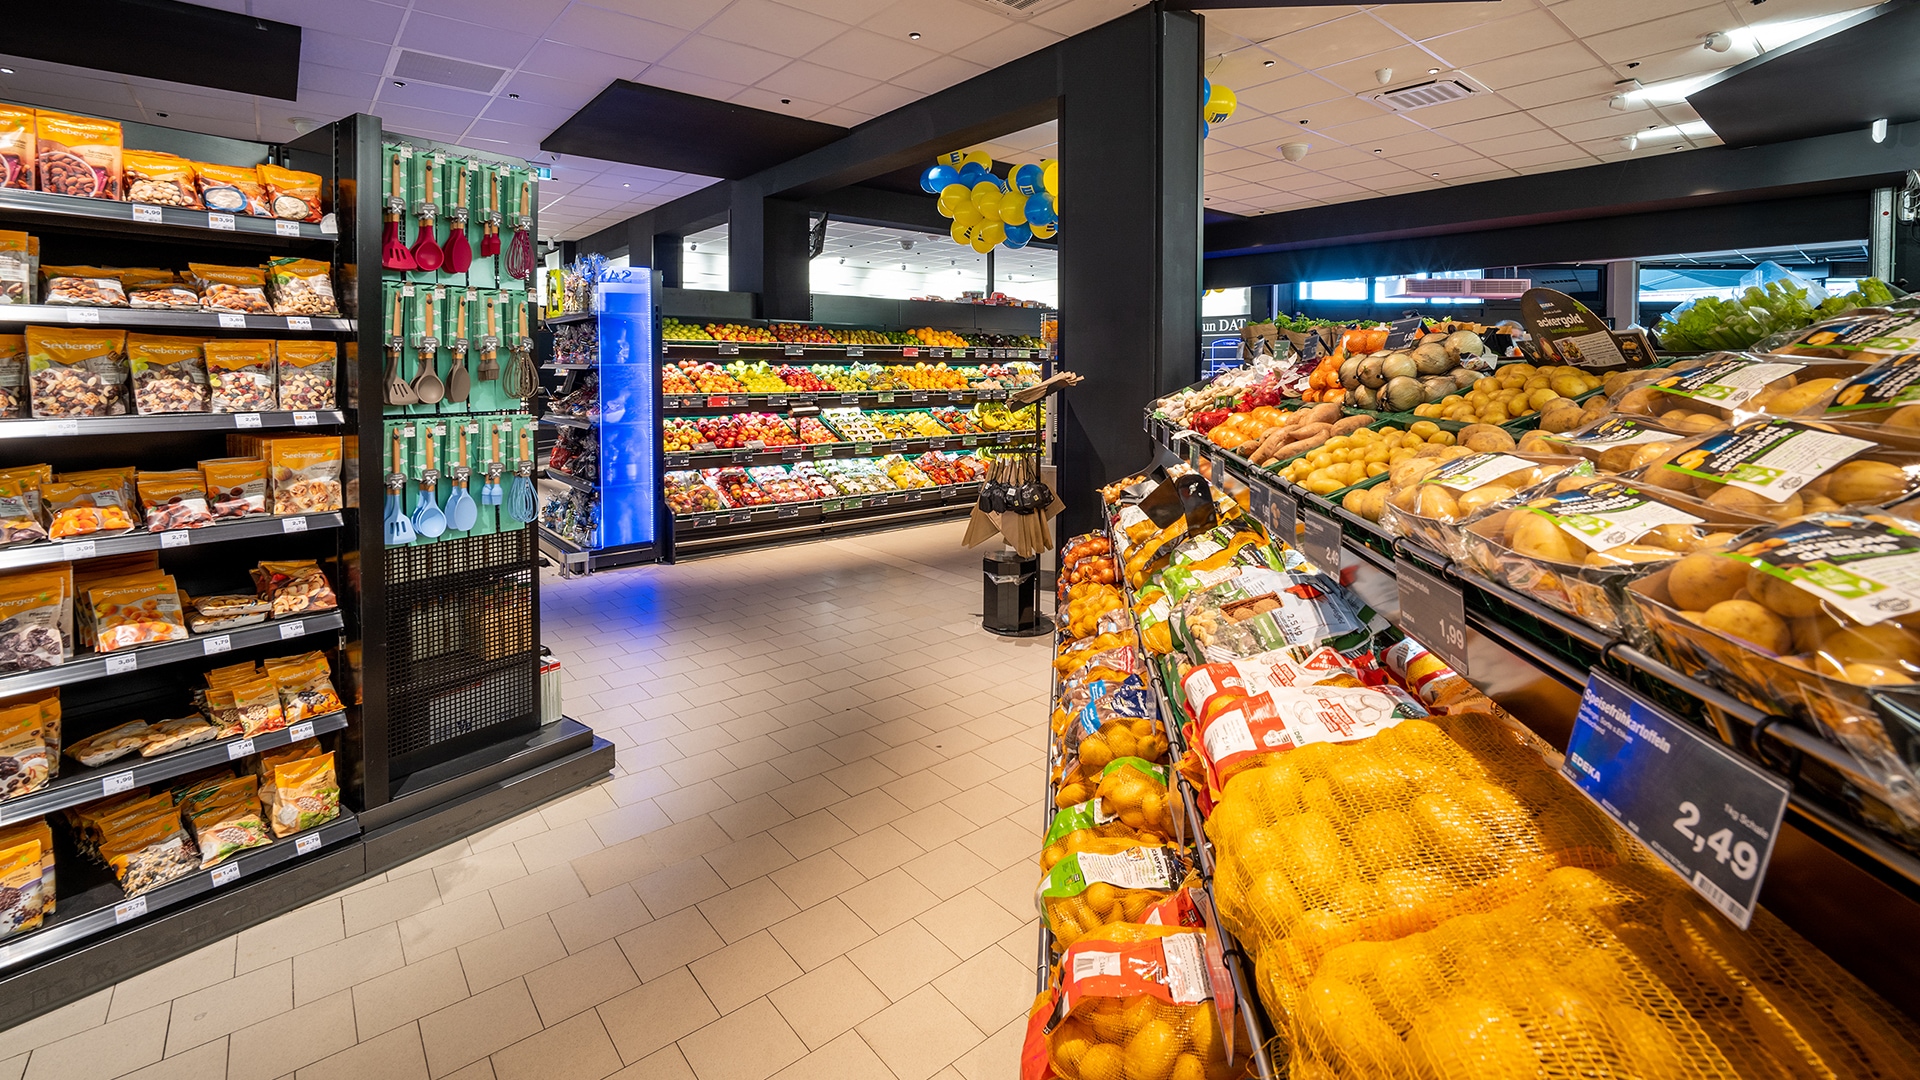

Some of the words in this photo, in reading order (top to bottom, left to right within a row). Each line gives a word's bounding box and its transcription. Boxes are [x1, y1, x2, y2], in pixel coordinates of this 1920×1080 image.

[47, 124, 99, 140] Seeberger
[206, 271, 250, 282] Seeberger
[1536, 313, 1585, 329] ackergold
[40, 339, 104, 351] Seeberger
[139, 345, 195, 355] Seeberger
[1708, 425, 1781, 469] ackergold
[281, 451, 326, 460] Seeberger
[214, 472, 254, 480] Seeberger
[147, 486, 192, 496] Seeberger
[171, 533, 188, 541] 2,79
[1325, 546, 1340, 567] 2,49
[103, 585, 157, 597] Seeberger
[1439, 618, 1465, 650] 1,99
[278, 667, 318, 682] Seeberger
[1584, 688, 1672, 754] Speisefrühkartoffeln
[1570, 751, 1602, 783] EDEKA
[1738, 813, 1771, 841] Schale
[1672, 800, 1760, 881] 2,49
